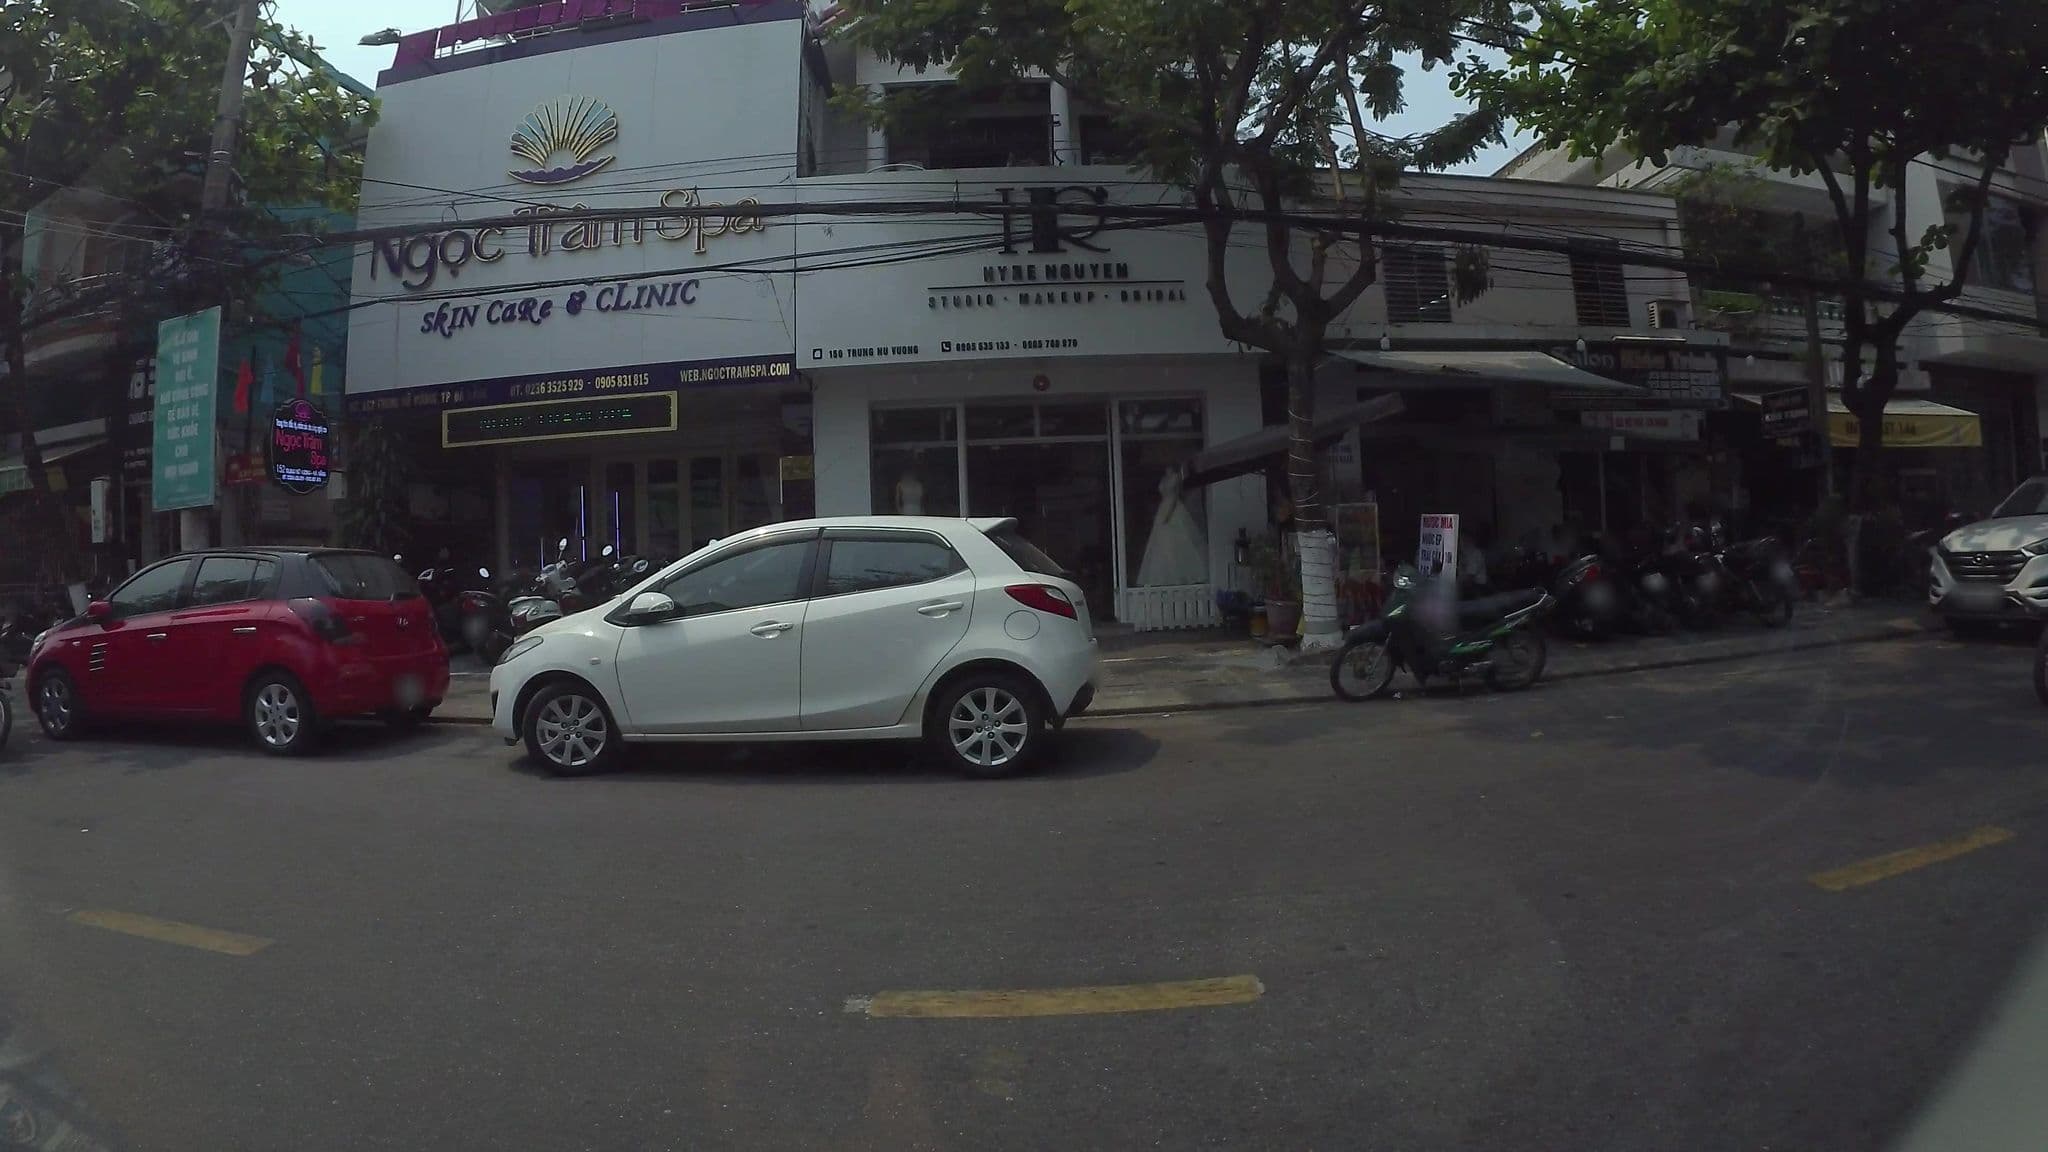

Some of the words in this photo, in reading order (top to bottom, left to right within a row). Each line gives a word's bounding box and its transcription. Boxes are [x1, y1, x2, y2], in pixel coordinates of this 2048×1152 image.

[656, 189, 766, 254] Spa
[595, 278, 700, 312] CLINIC
[928, 294, 994, 309] STUDIO
[1018, 290, 1096, 305] MAKEUP
